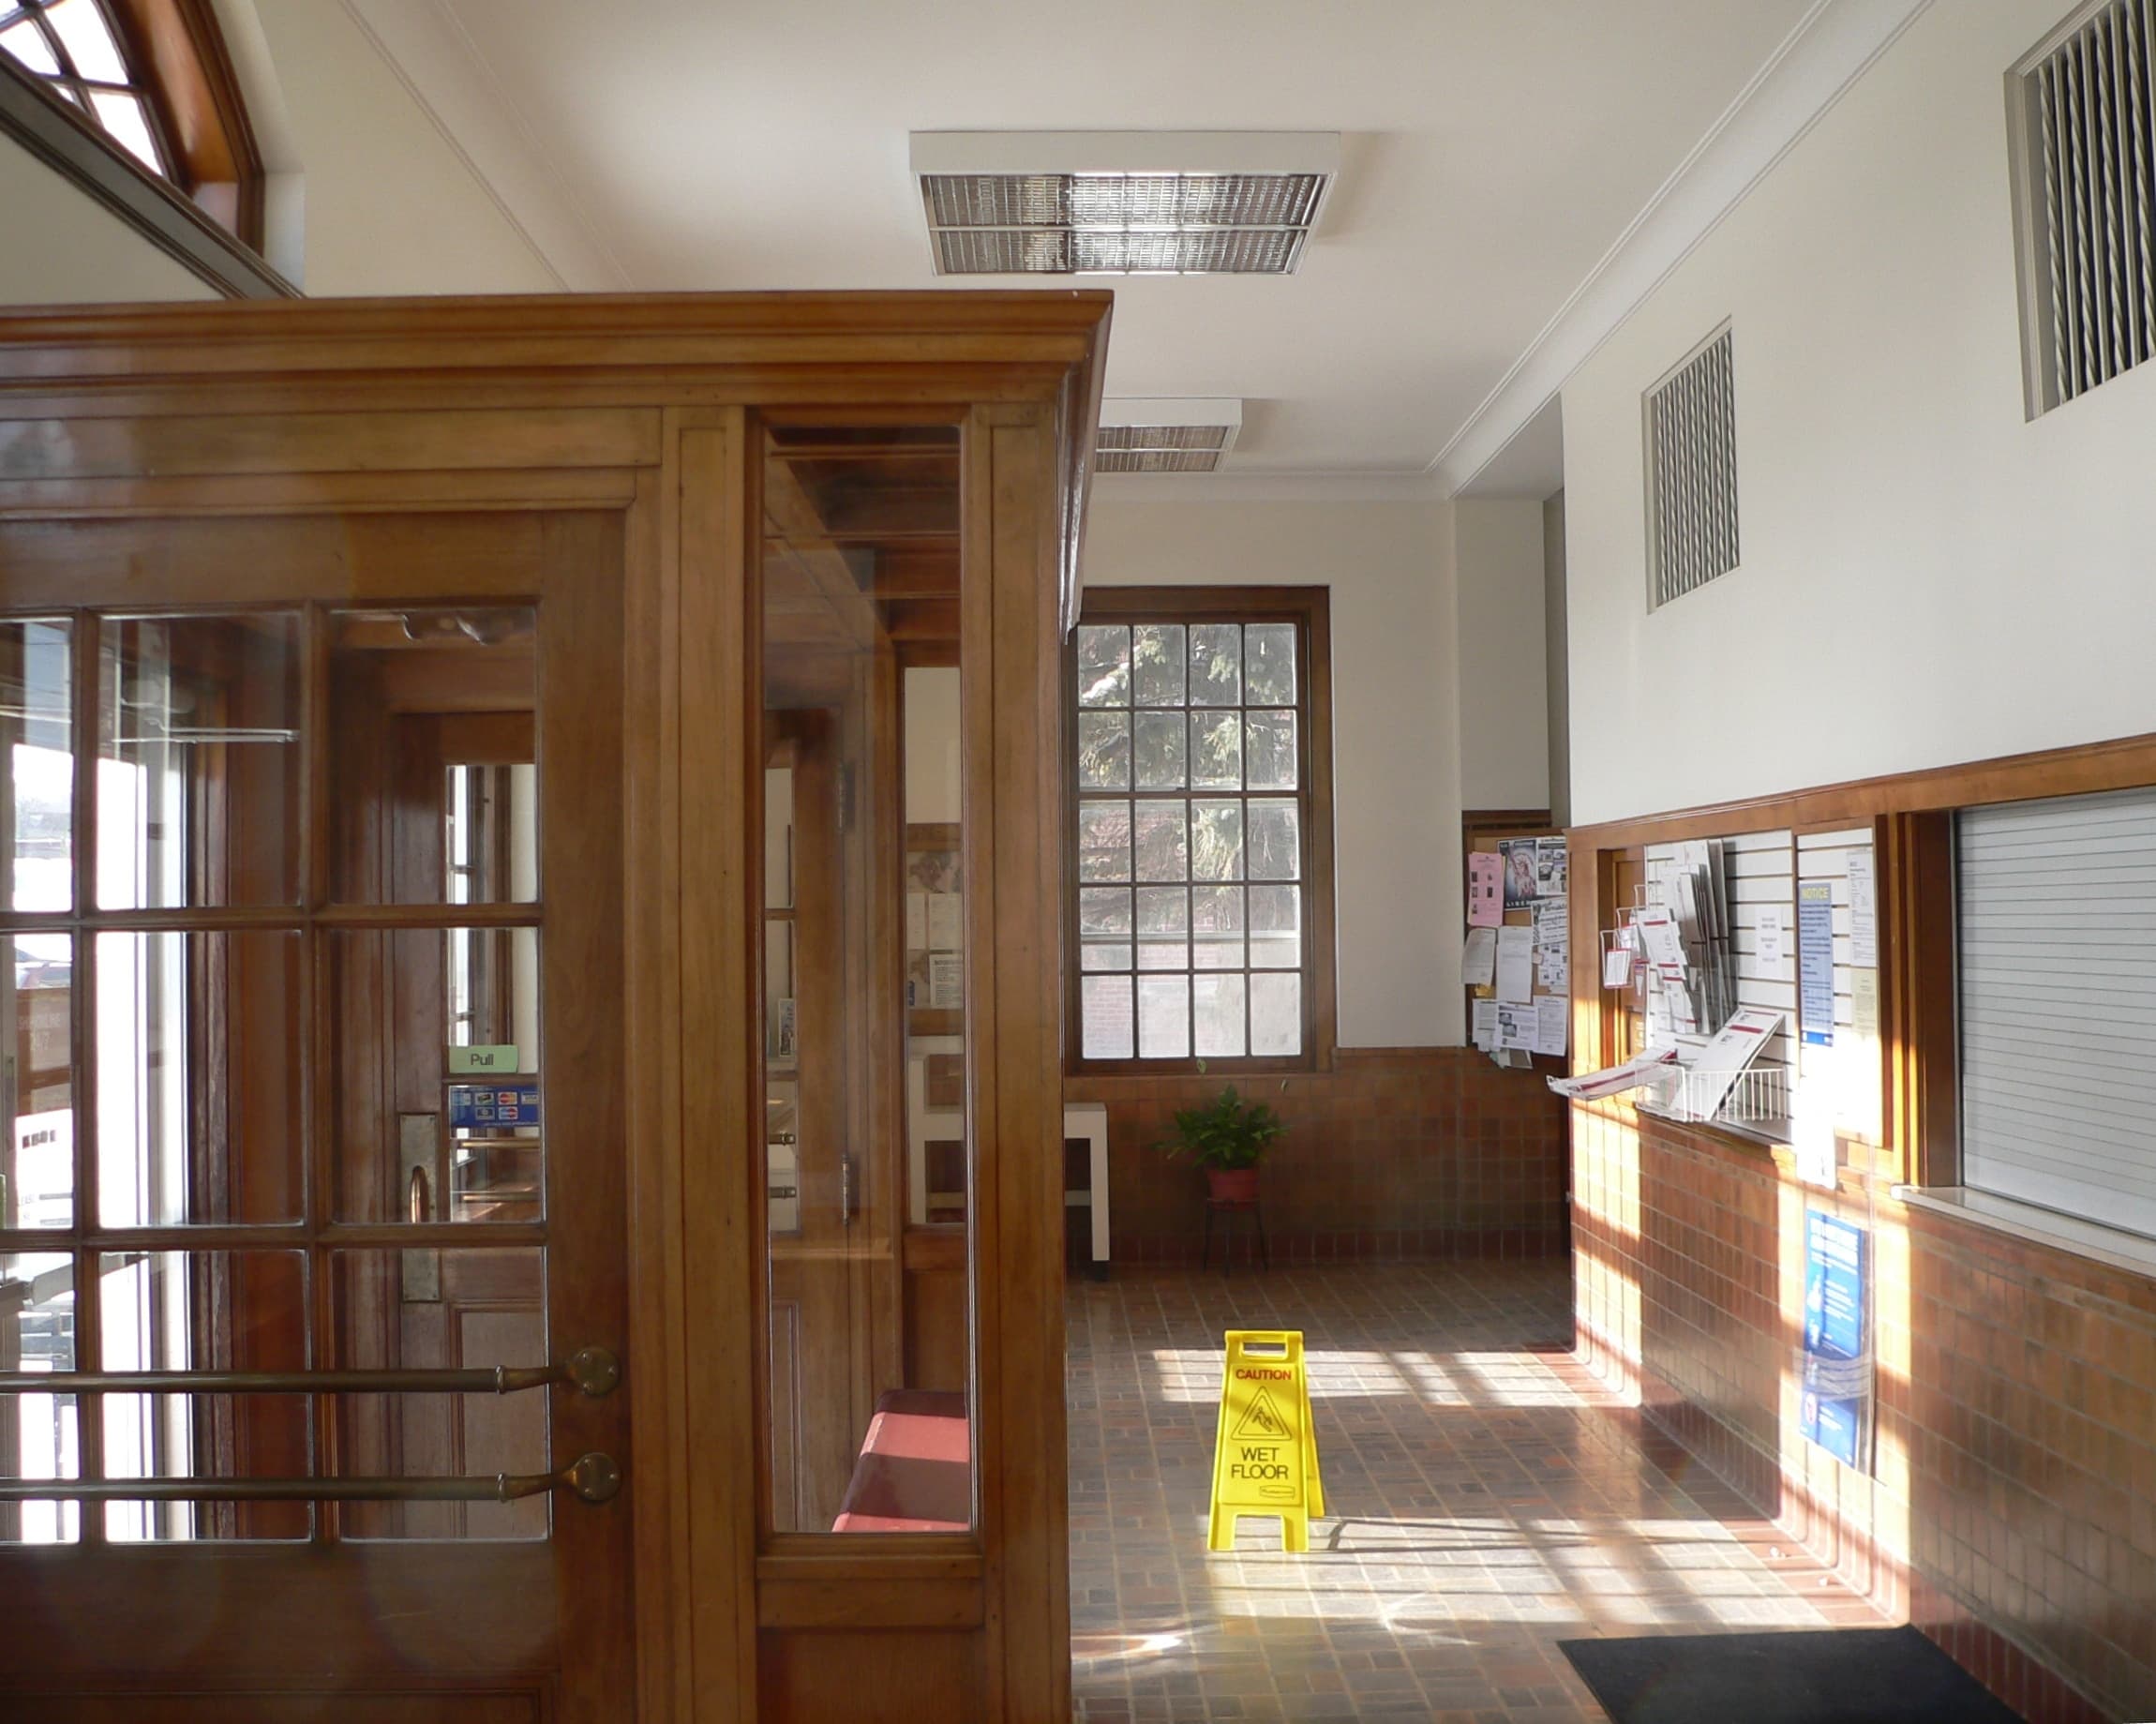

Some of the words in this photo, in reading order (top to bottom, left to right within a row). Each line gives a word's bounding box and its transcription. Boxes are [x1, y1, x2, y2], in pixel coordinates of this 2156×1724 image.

[471, 1053, 494, 1066] Pull
[1235, 1369, 1292, 1381] CAUTION
[1241, 1447, 1280, 1462] WET
[1231, 1464, 1289, 1479] FLOOR
